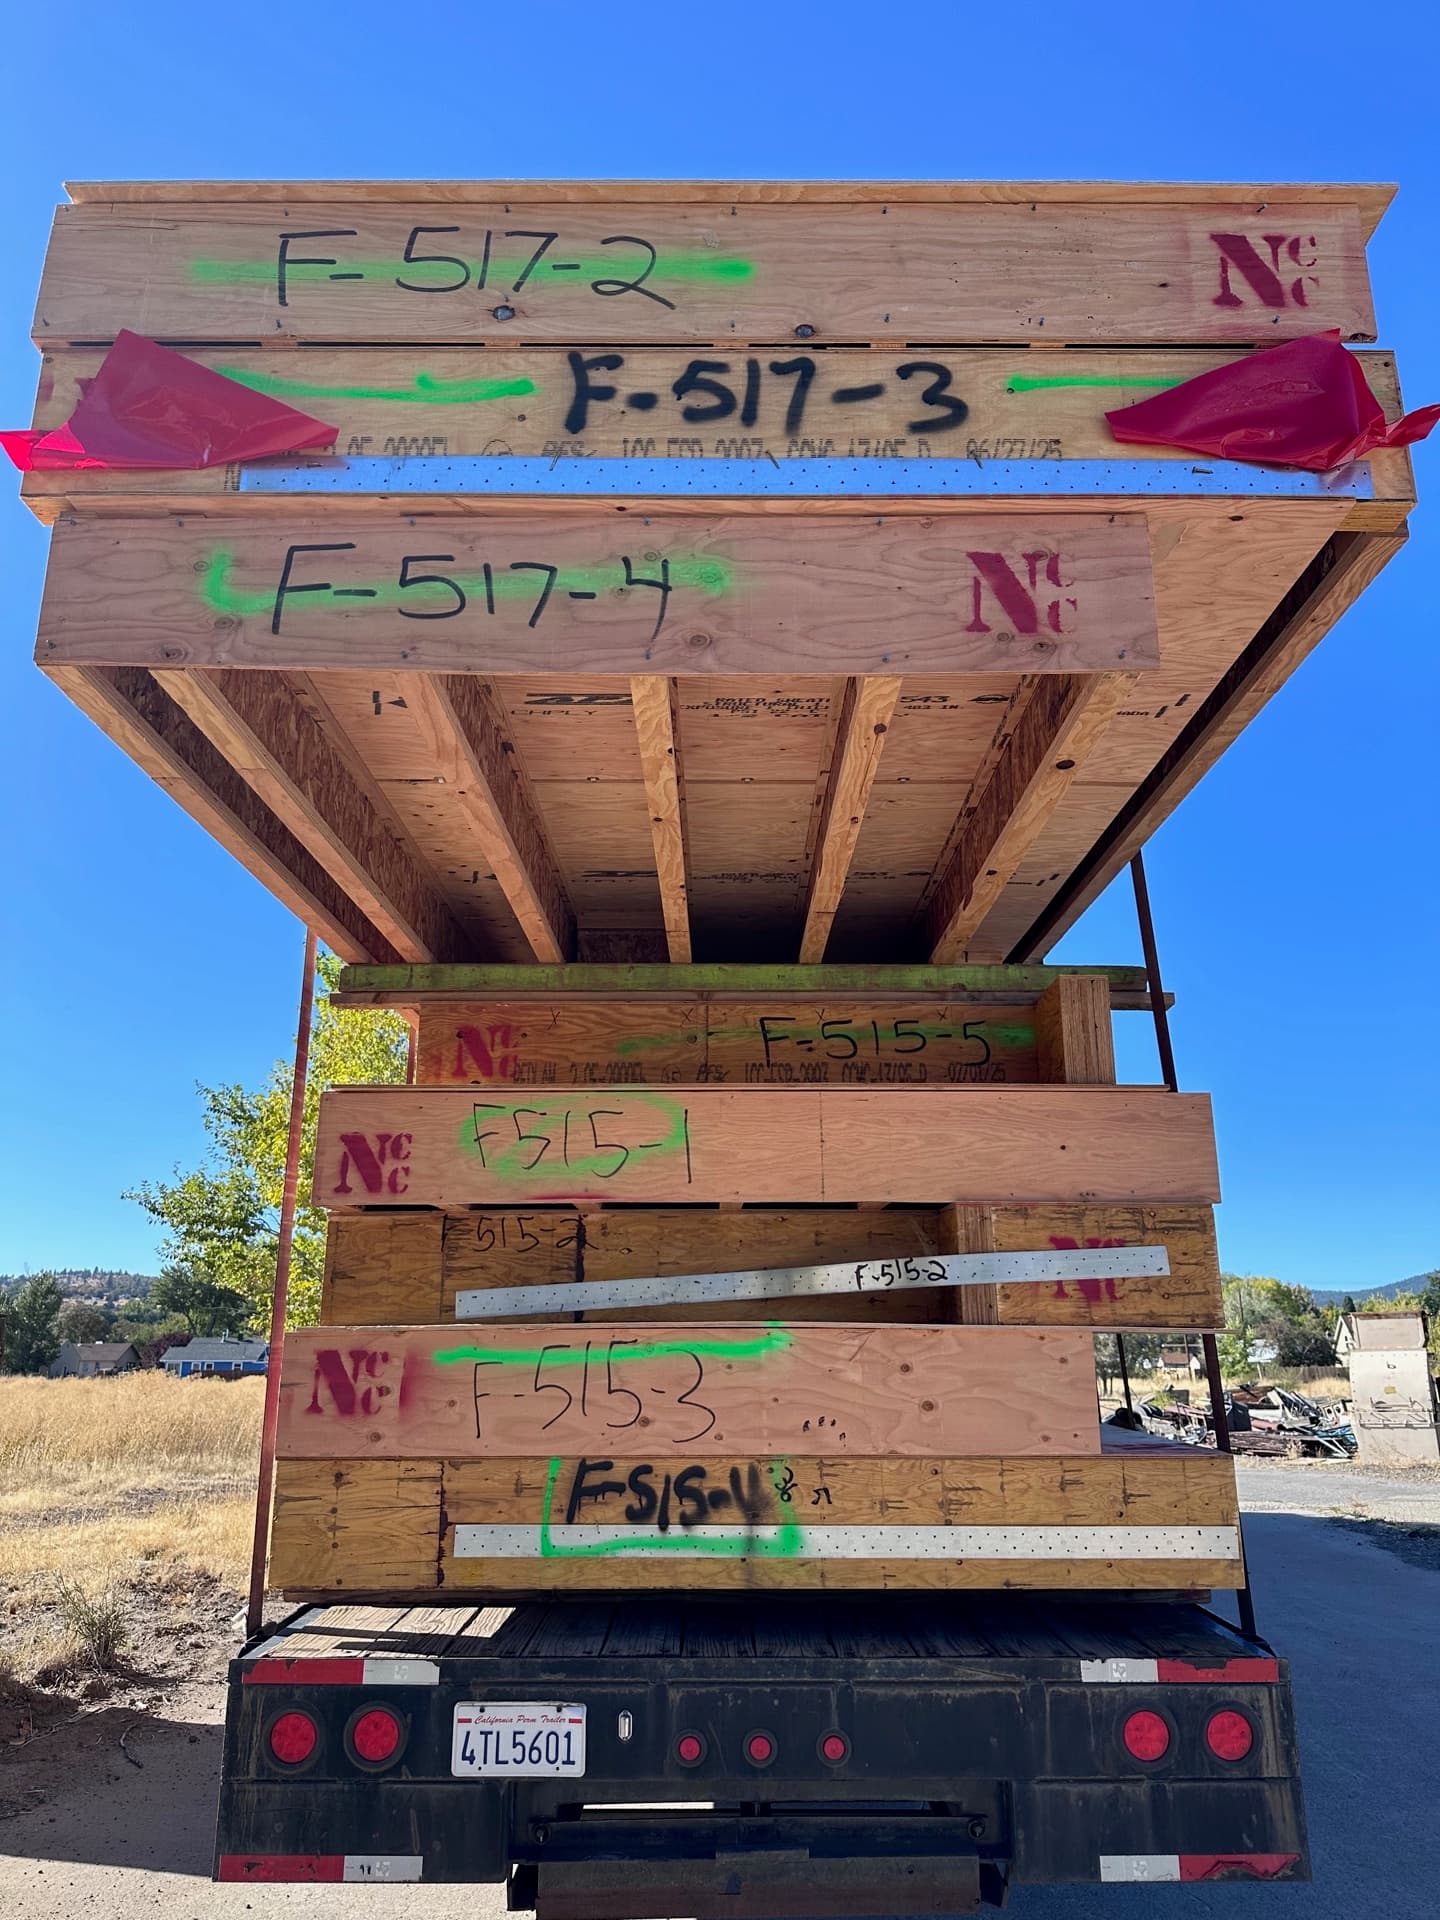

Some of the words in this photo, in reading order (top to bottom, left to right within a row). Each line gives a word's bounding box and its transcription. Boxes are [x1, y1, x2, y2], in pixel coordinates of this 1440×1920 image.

[278, 226, 676, 309] F-517-2
[565, 351, 970, 436] F-517-3
[271, 542, 674, 649] F-517-4
[758, 1016, 992, 1068] F-515-5
[473, 1339, 717, 1443] F-515-3
[461, 1730, 577, 1766] 4TL5601
[474, 1715, 514, 1727] California
[516, 1714, 537, 1724] Perm
[541, 1714, 567, 1724] Trailer
